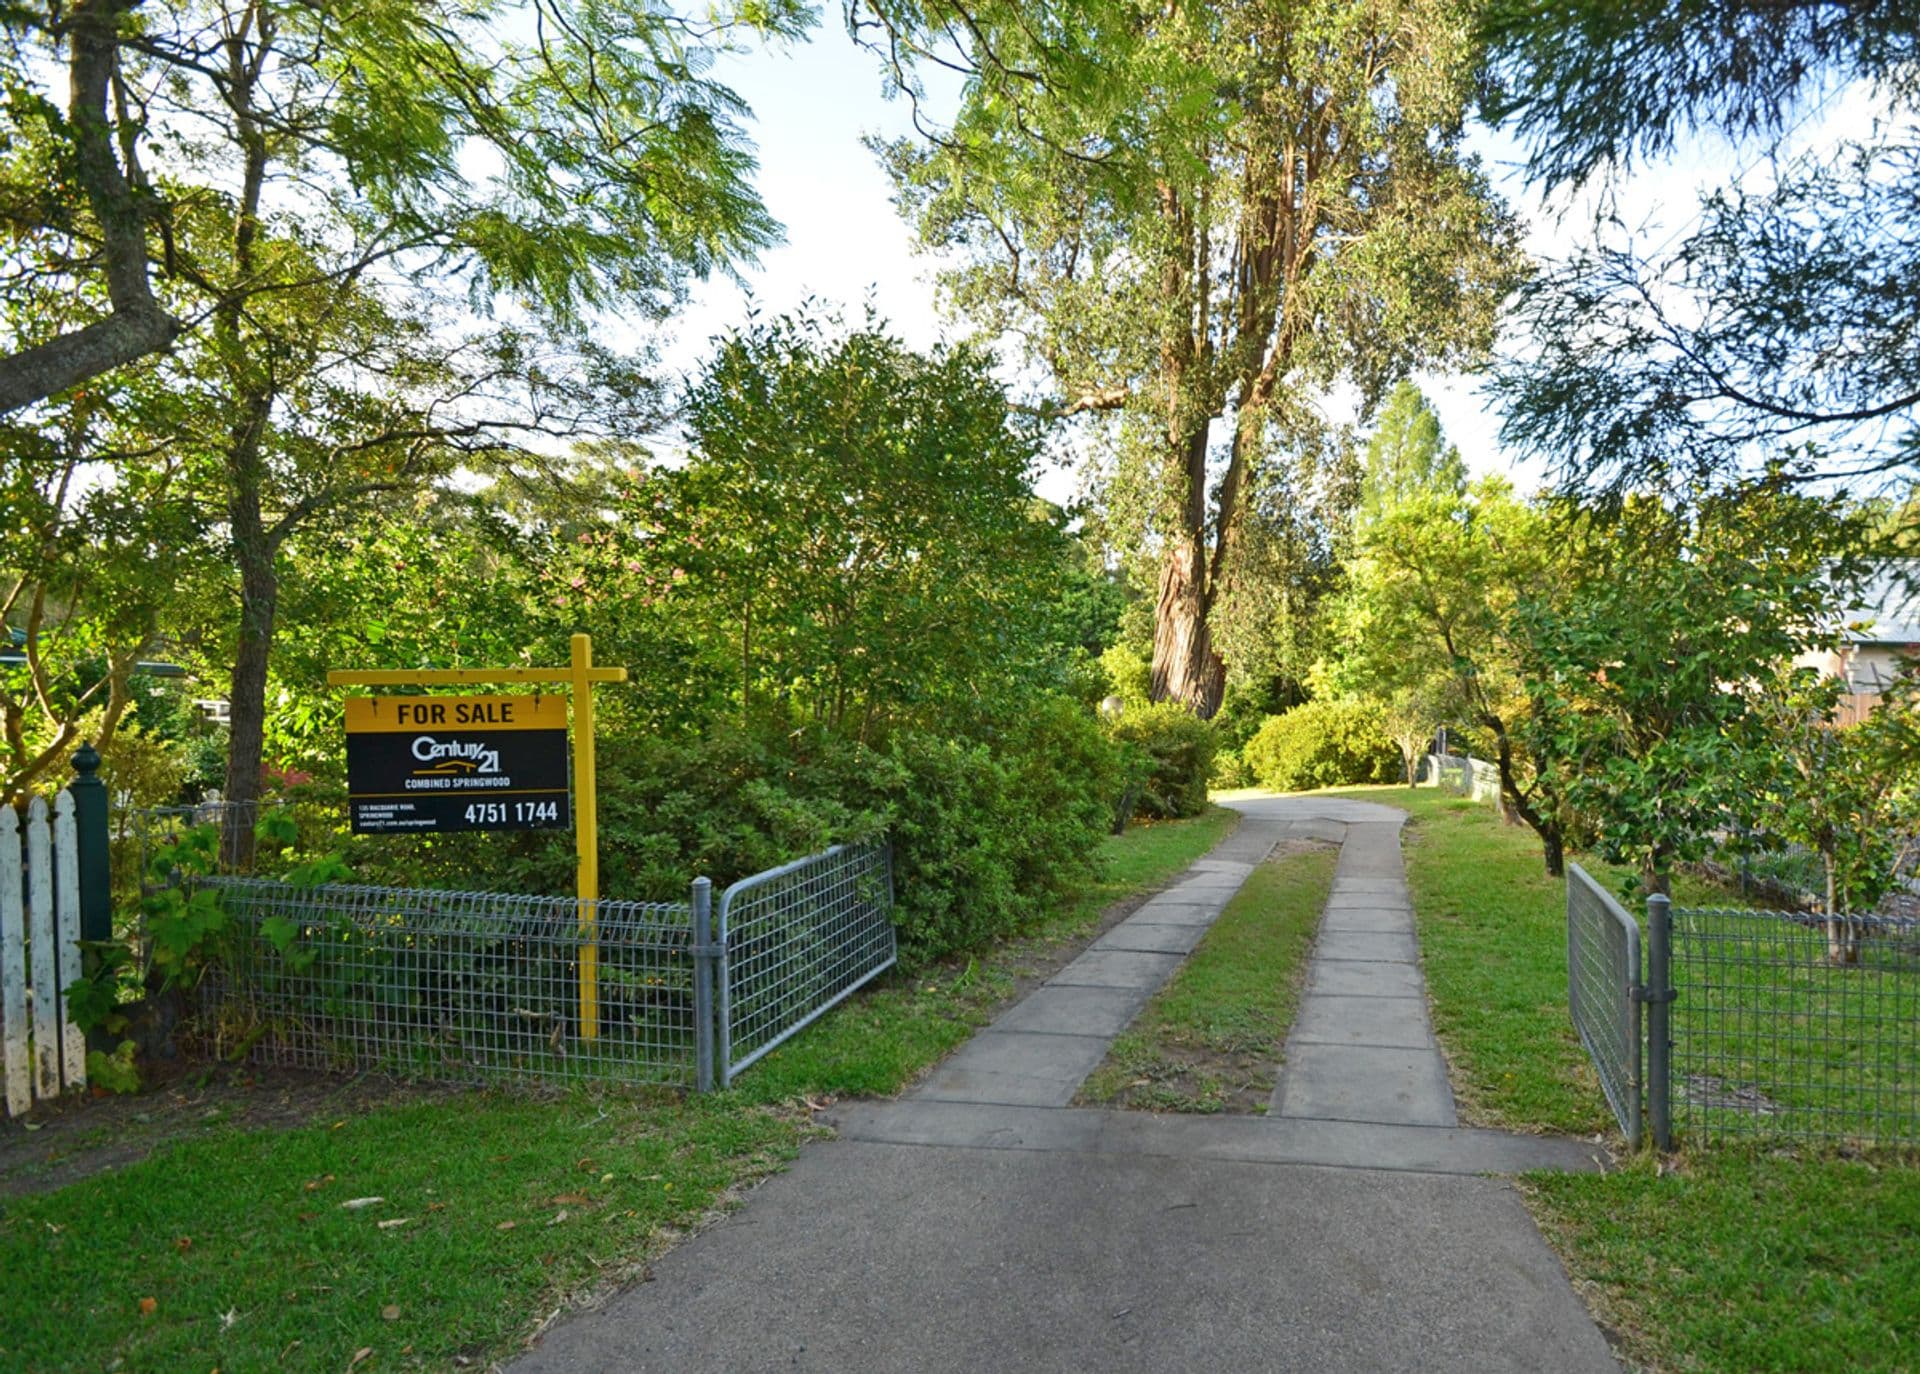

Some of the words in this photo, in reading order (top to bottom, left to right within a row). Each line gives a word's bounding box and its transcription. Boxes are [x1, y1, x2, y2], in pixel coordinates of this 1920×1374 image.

[398, 704, 446, 725] FOR
[456, 703, 514, 723] SALE
[411, 735, 485, 762] Century
[477, 750, 500, 773] 21
[404, 778, 451, 789] COMBINED
[452, 776, 511, 788] SPRINGWOOD
[464, 803, 507, 823] 4751
[515, 801, 558, 822] 1744
